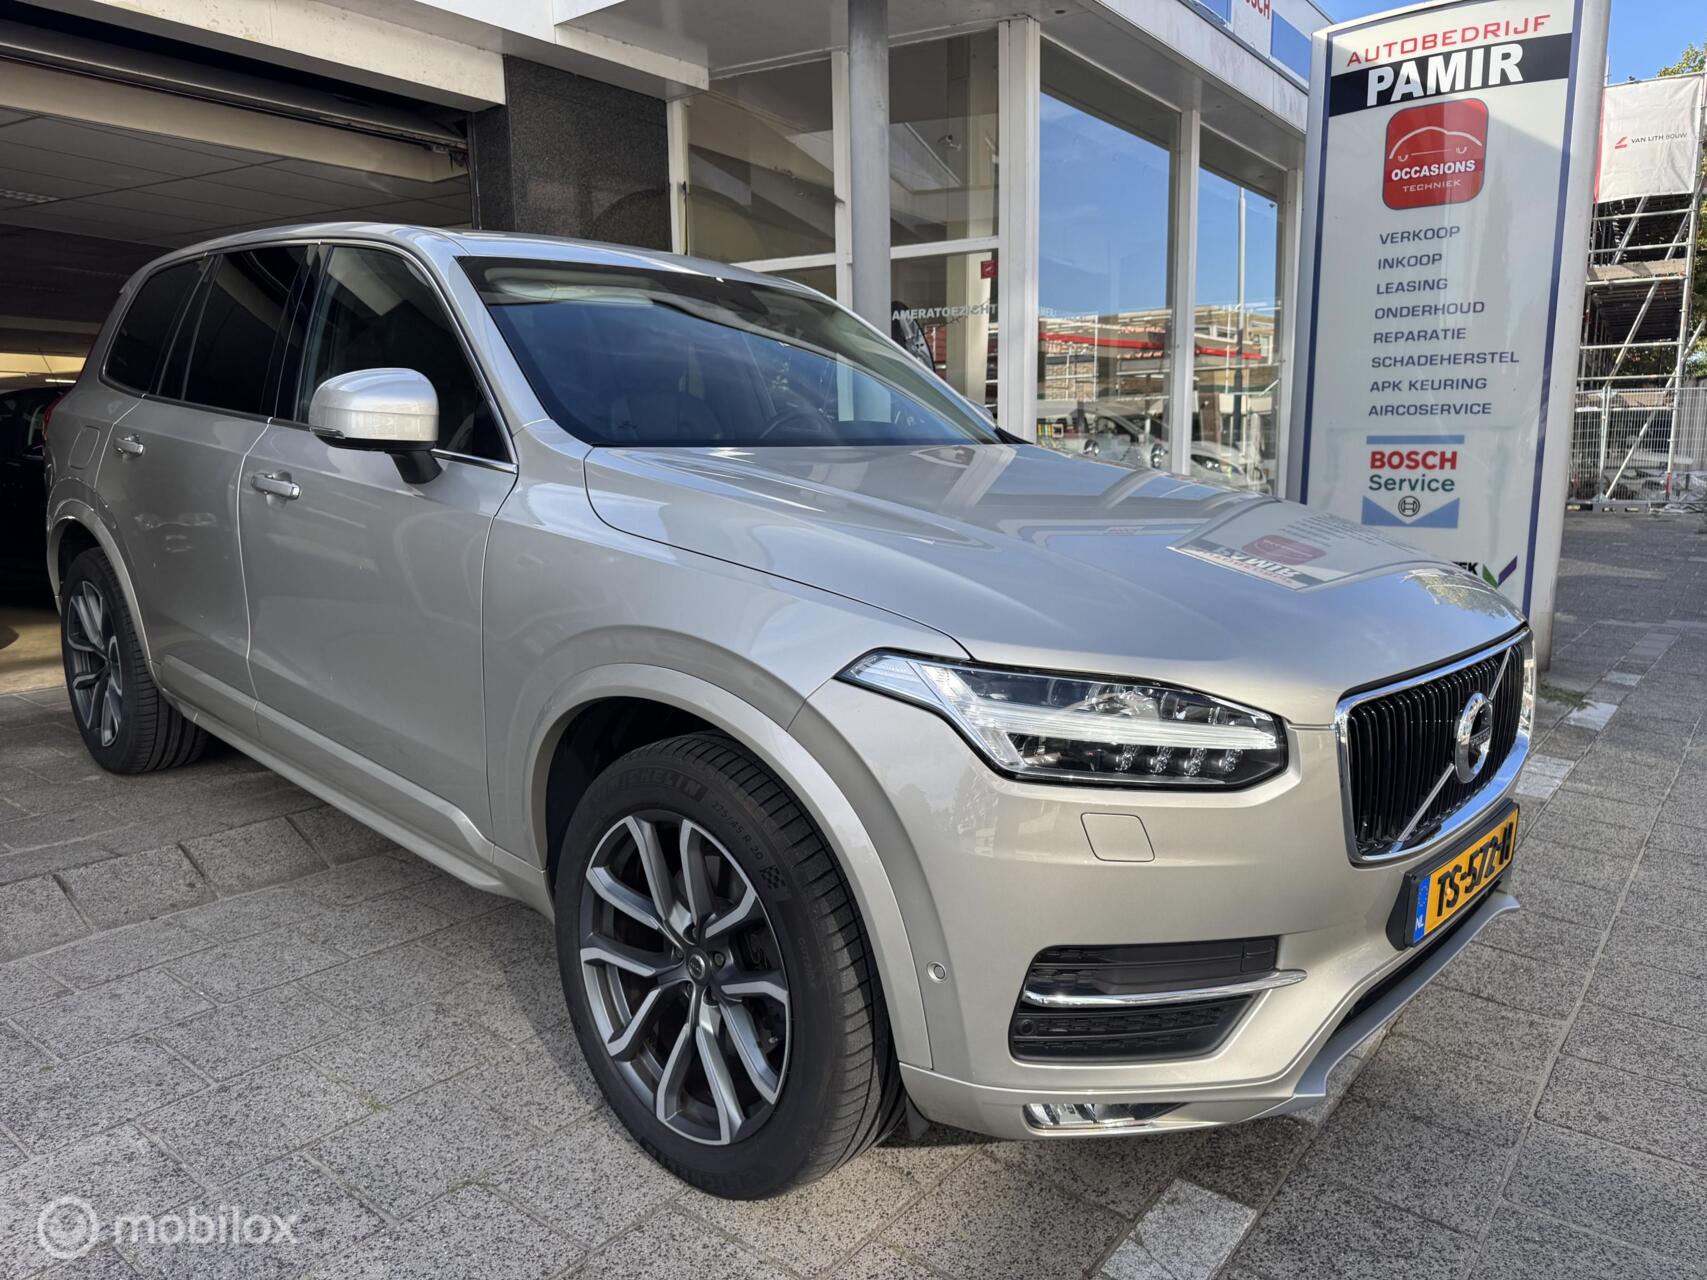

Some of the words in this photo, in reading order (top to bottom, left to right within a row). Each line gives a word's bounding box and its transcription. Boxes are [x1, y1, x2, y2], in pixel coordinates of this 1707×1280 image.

[1347, 15, 1551, 67] AUTOBEDRIJF
[1367, 43, 1524, 106] PAMIR
[1631, 136, 1646, 144] VAN
[1666, 132, 1687, 140] BOUW
[1391, 160, 1476, 181] OCCASIONS
[1402, 179, 1461, 192] TECHNIEK
[1379, 226, 1460, 245] VERKOOP
[1377, 253, 1443, 270] INKOOP
[1376, 278, 1448, 295] LEASING
[892, 303, 998, 321] AMERATOEZICHT
[1374, 301, 1485, 320] ONDERHOUD
[1373, 328, 1467, 345] REPARATIE
[1371, 351, 1520, 369] SCHADEHERSTEL
[1369, 380, 1403, 393] APK
[1408, 377, 1487, 392] KEURING
[1368, 402, 1493, 417] AIRCOSERVICE
[1369, 450, 1458, 471] BOSCH
[1368, 473, 1456, 492] Service
[1437, 822, 1514, 917] TS-572-H
[1414, 914, 1425, 931] NL
